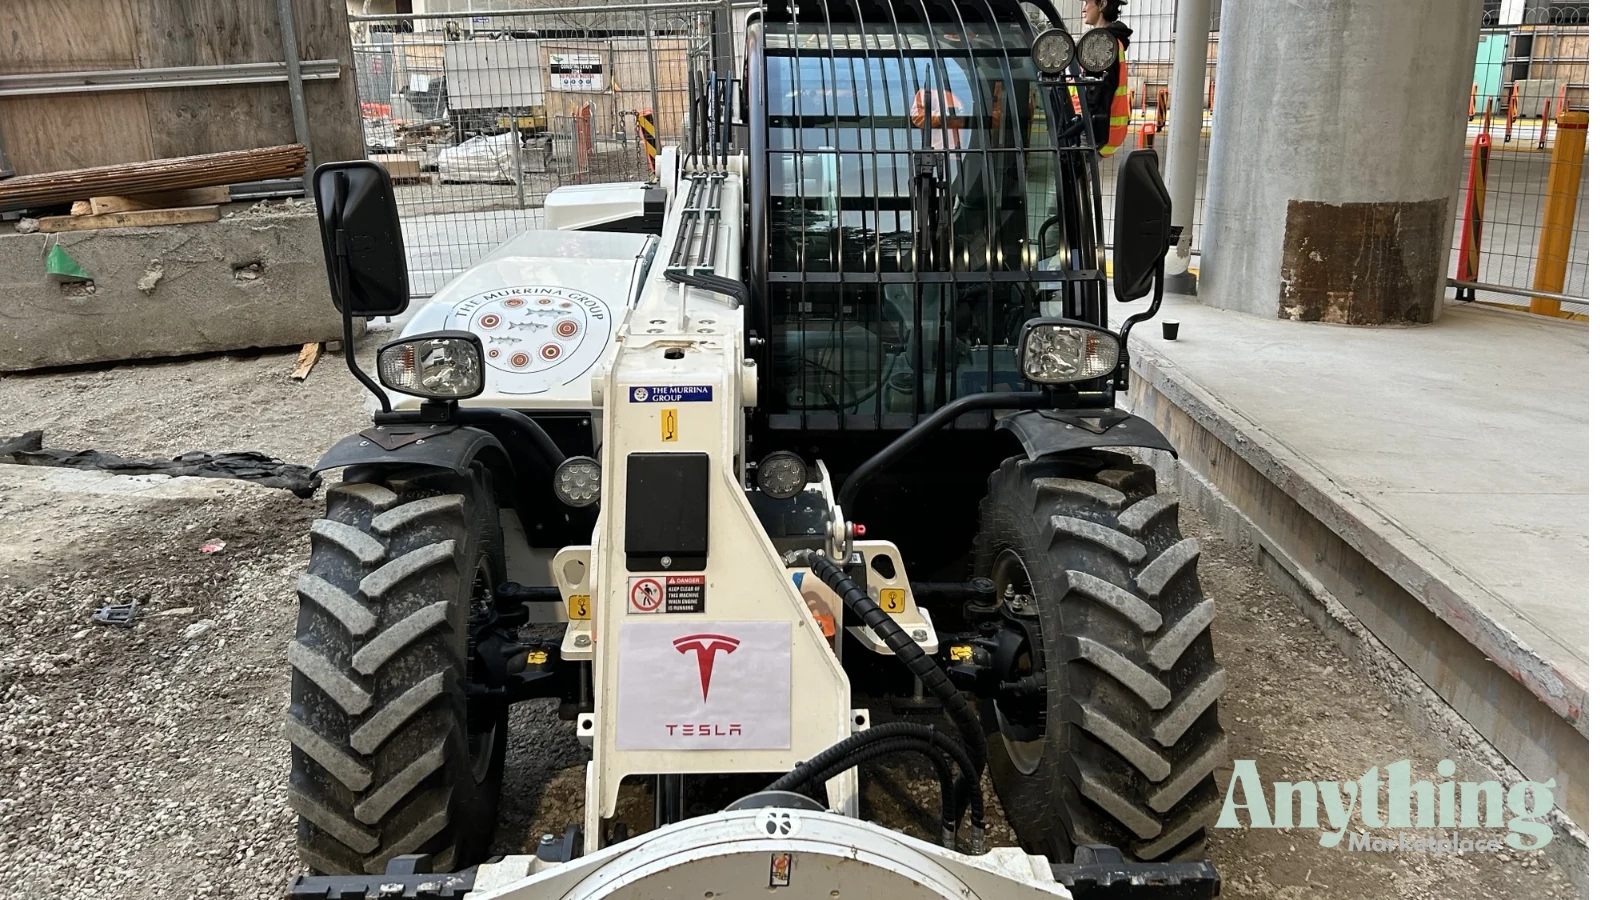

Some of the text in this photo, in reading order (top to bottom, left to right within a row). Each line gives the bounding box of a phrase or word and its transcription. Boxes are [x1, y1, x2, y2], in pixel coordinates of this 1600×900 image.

[455, 288, 604, 320] THE MURRINA GROUP
[669, 386, 708, 394] MURRINA
[652, 394, 682, 402] GROUP
[665, 724, 741, 736] TESLA
